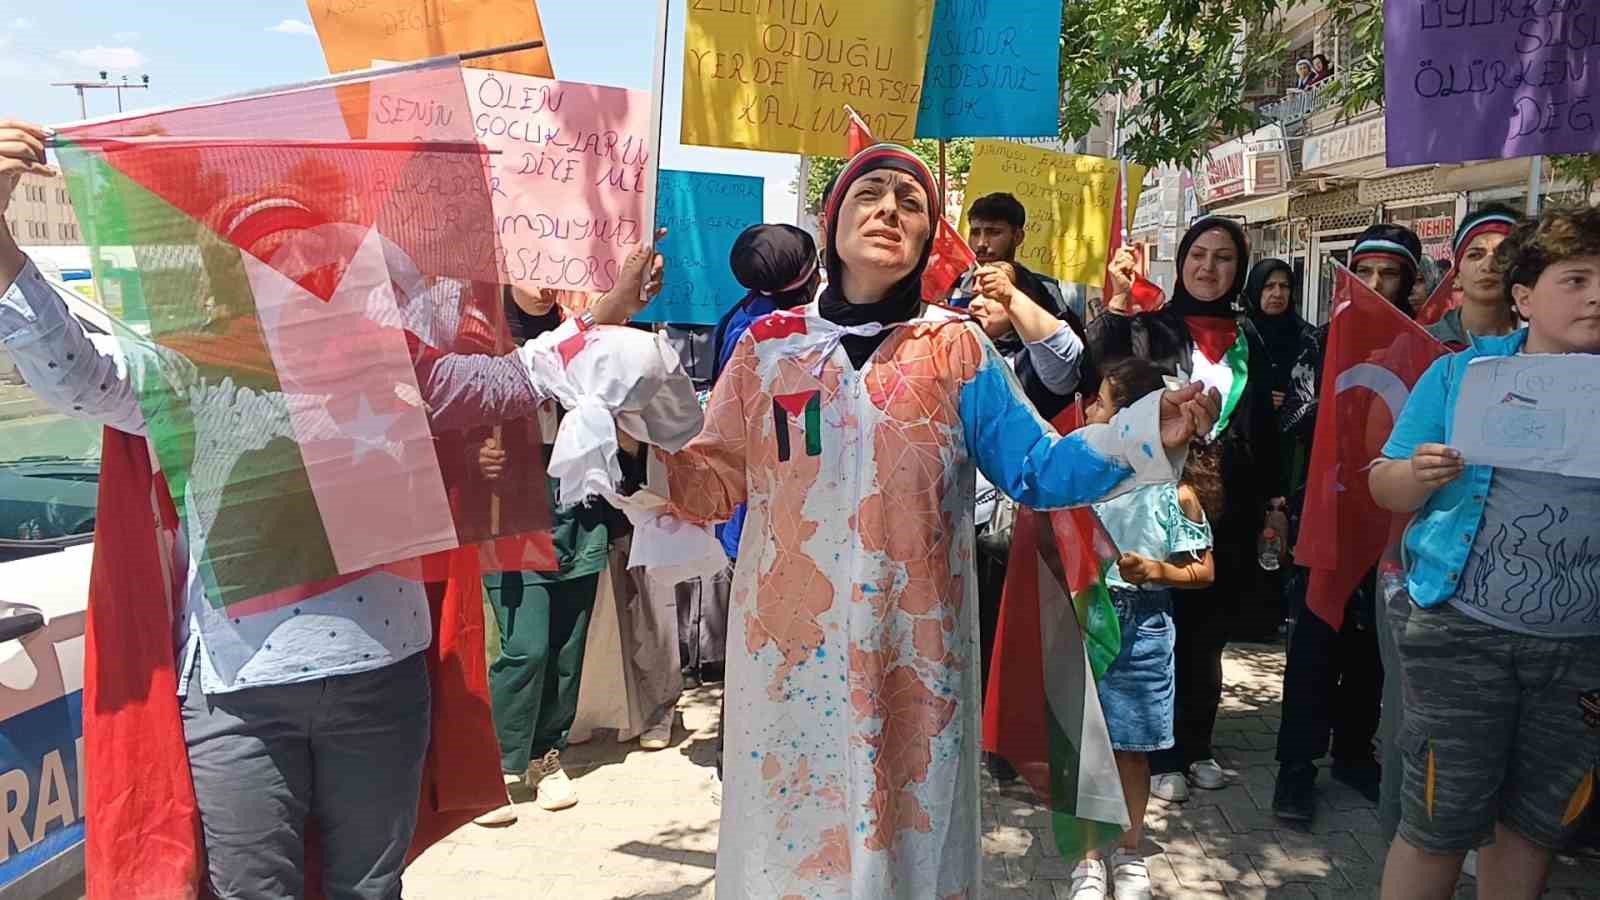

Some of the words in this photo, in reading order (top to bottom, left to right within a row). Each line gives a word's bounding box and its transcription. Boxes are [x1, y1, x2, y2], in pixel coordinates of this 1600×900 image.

[690, 48, 788, 87] YERDE
[762, 24, 893, 71] OLDUĞU
[478, 72, 564, 113] ÖLEN
[1414, 59, 1587, 98] ÖLÜRKEN
[517, 150, 580, 183] DİYE
[0, 735, 85, 863] RA
